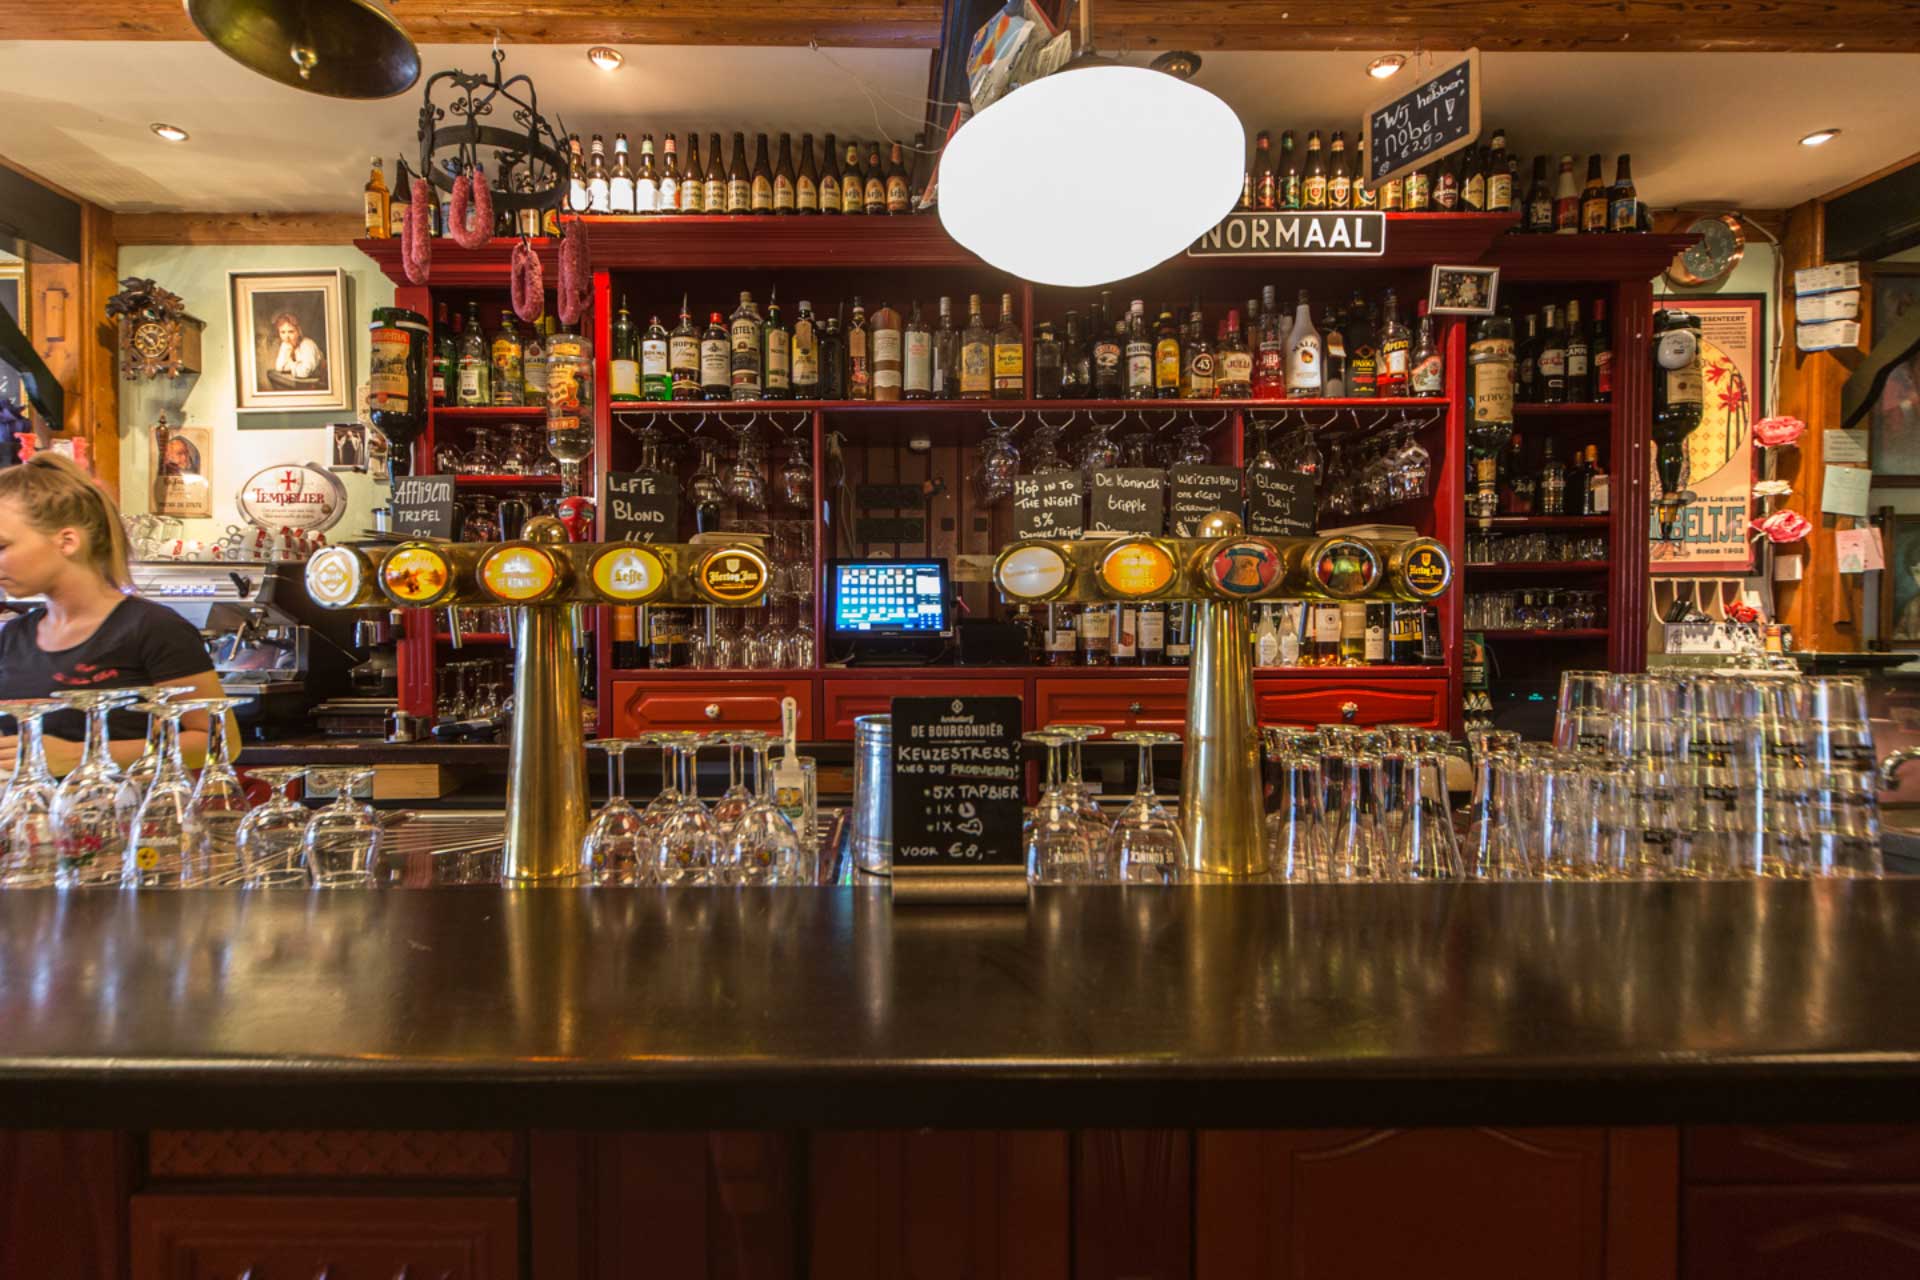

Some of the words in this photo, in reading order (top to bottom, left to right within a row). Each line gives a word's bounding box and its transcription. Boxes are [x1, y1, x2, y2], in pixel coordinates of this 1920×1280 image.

[1201, 217, 1373, 249] NORMAAL
[608, 476, 656, 495] LEFFE
[1095, 472, 1113, 487] De
[252, 487, 326, 507] TEMPELIER
[393, 480, 451, 505] Affligem
[398, 509, 441, 523] TRIPEL
[612, 499, 665, 523] BLOND
[615, 568, 644, 585] Leffe
[911, 724, 926, 738] DE
[959, 784, 1019, 799] TAPBIER
